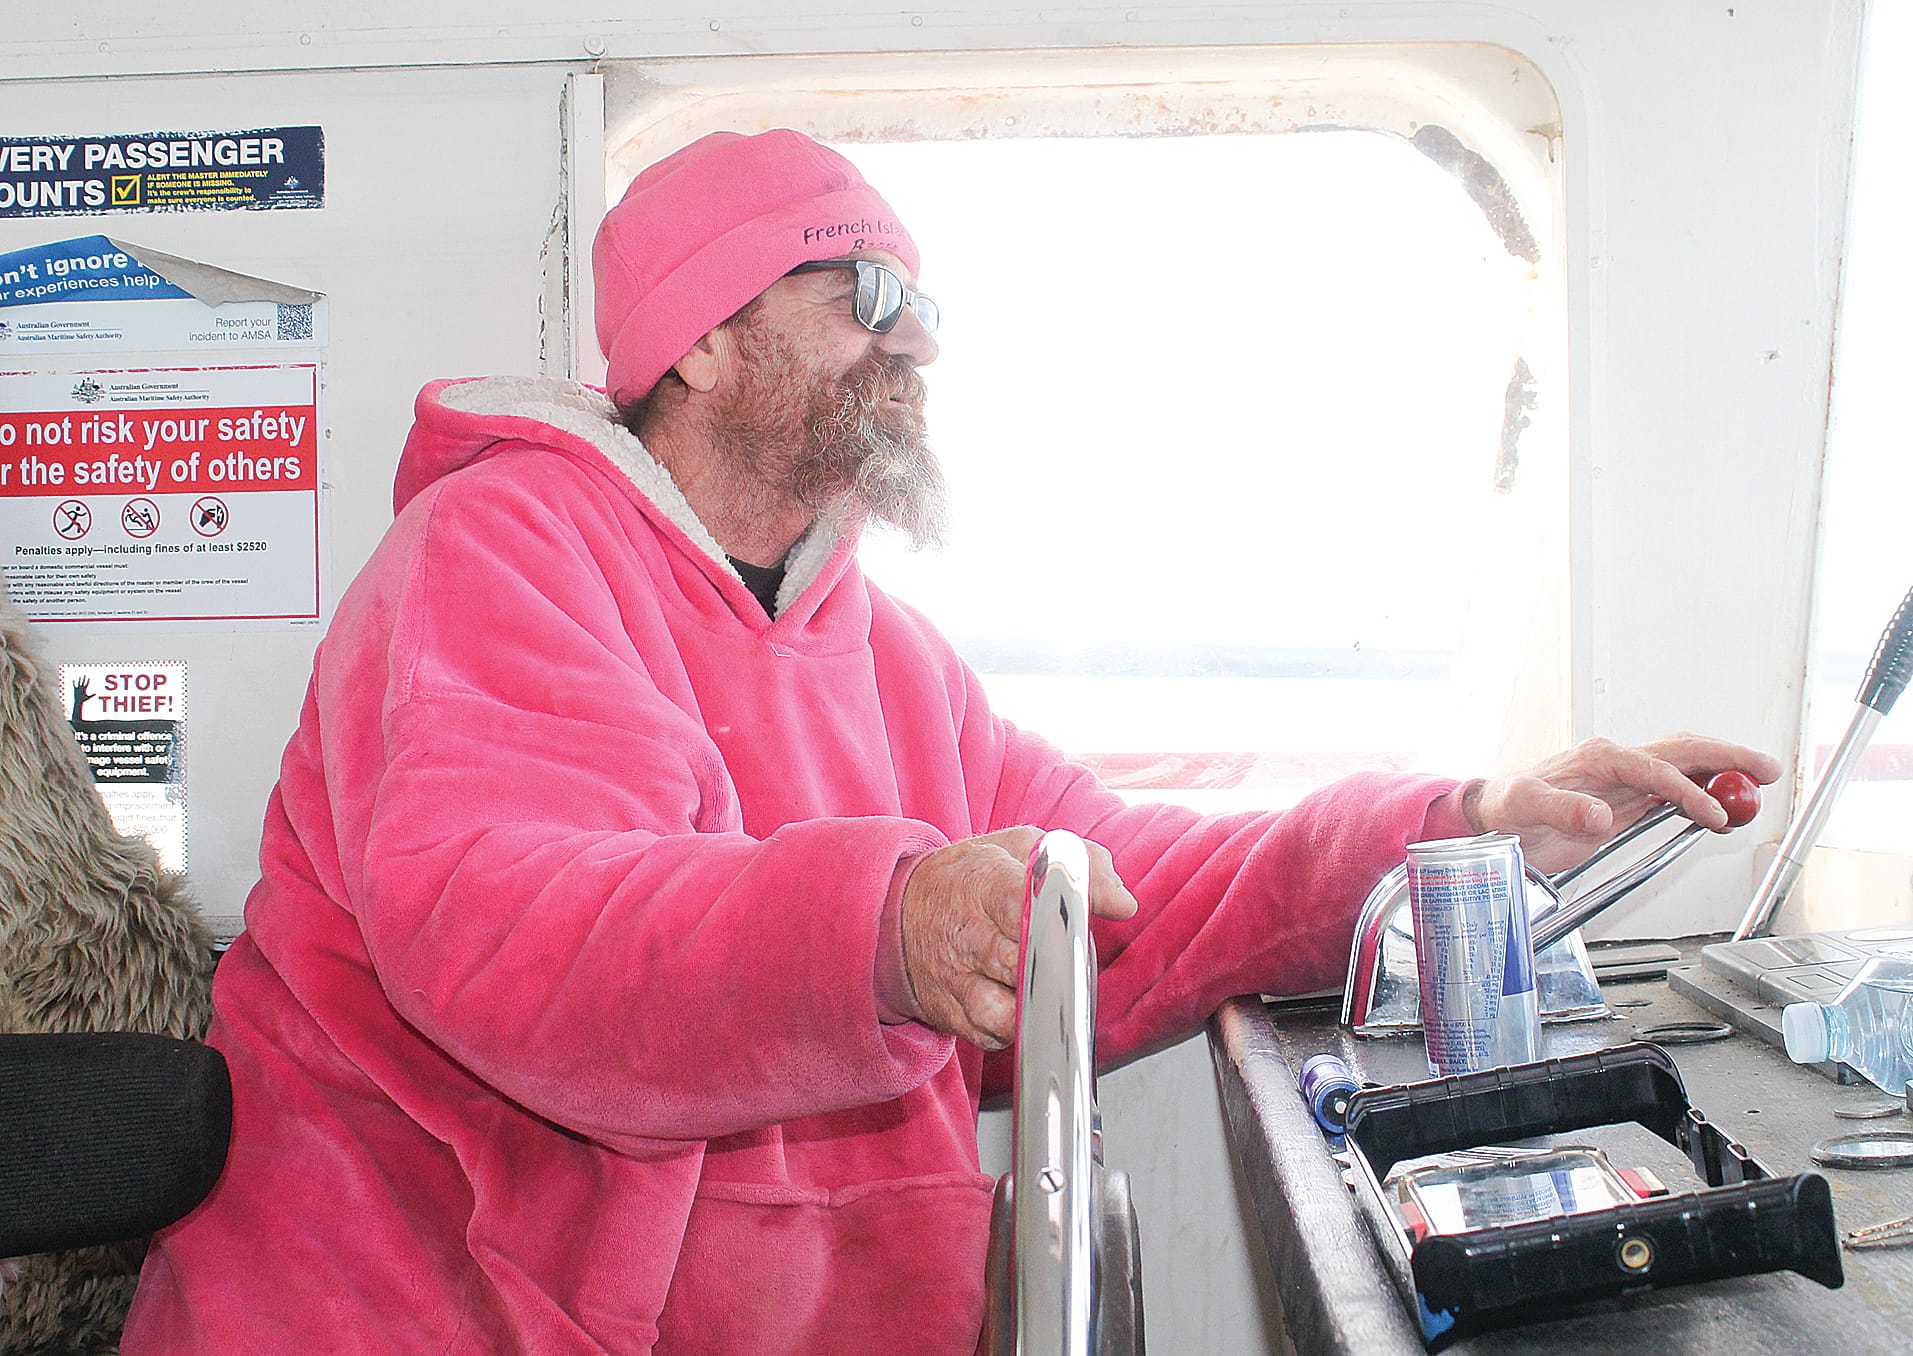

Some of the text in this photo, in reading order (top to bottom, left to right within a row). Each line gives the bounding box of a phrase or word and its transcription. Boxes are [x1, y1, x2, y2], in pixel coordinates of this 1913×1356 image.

[84, 138, 285, 171] PASSENGER
[220, 170, 268, 178] IMMEDIATELY
[202, 179, 234, 187] MISSING.
[0, 180, 106, 208] OUNTS
[197, 187, 243, 196] responsibility
[185, 196, 216, 204] everyone
[226, 194, 256, 202] counted.
[803, 219, 872, 245] French
[0, 264, 39, 284] n't
[45, 252, 128, 276] ignore
[15, 276, 118, 298] experiences
[123, 273, 160, 290] help
[215, 318, 271, 328] Report your
[76, 333, 93, 341] Safety
[95, 332, 122, 340] Authority
[229, 332, 239, 341] to
[241, 330, 271, 340] AMSA
[166, 394, 183, 402] Safety
[184, 393, 209, 401] Authority
[26, 415, 73, 445] not
[81, 413, 135, 444] risk
[143, 419, 209, 450] your
[218, 410, 306, 447] safety
[20, 455, 65, 485] the
[74, 454, 161, 490] safety
[170, 452, 200, 482] of
[208, 451, 301, 481] others
[15, 545, 62, 556] Penalties
[155, 543, 180, 553] fines
[183, 542, 194, 552] of
[196, 543, 206, 552] at
[209, 542, 234, 552] least
[236, 541, 267, 552] $2520
[104, 674, 167, 691] STOP
[98, 695, 173, 712] THIEF!
[98, 731, 135, 741] criminal
[137, 731, 173, 741] offence
[81, 743, 166, 753] to interfere with or
[87, 755, 173, 766] mage vessel safety
[96, 767, 149, 778] equipment.
